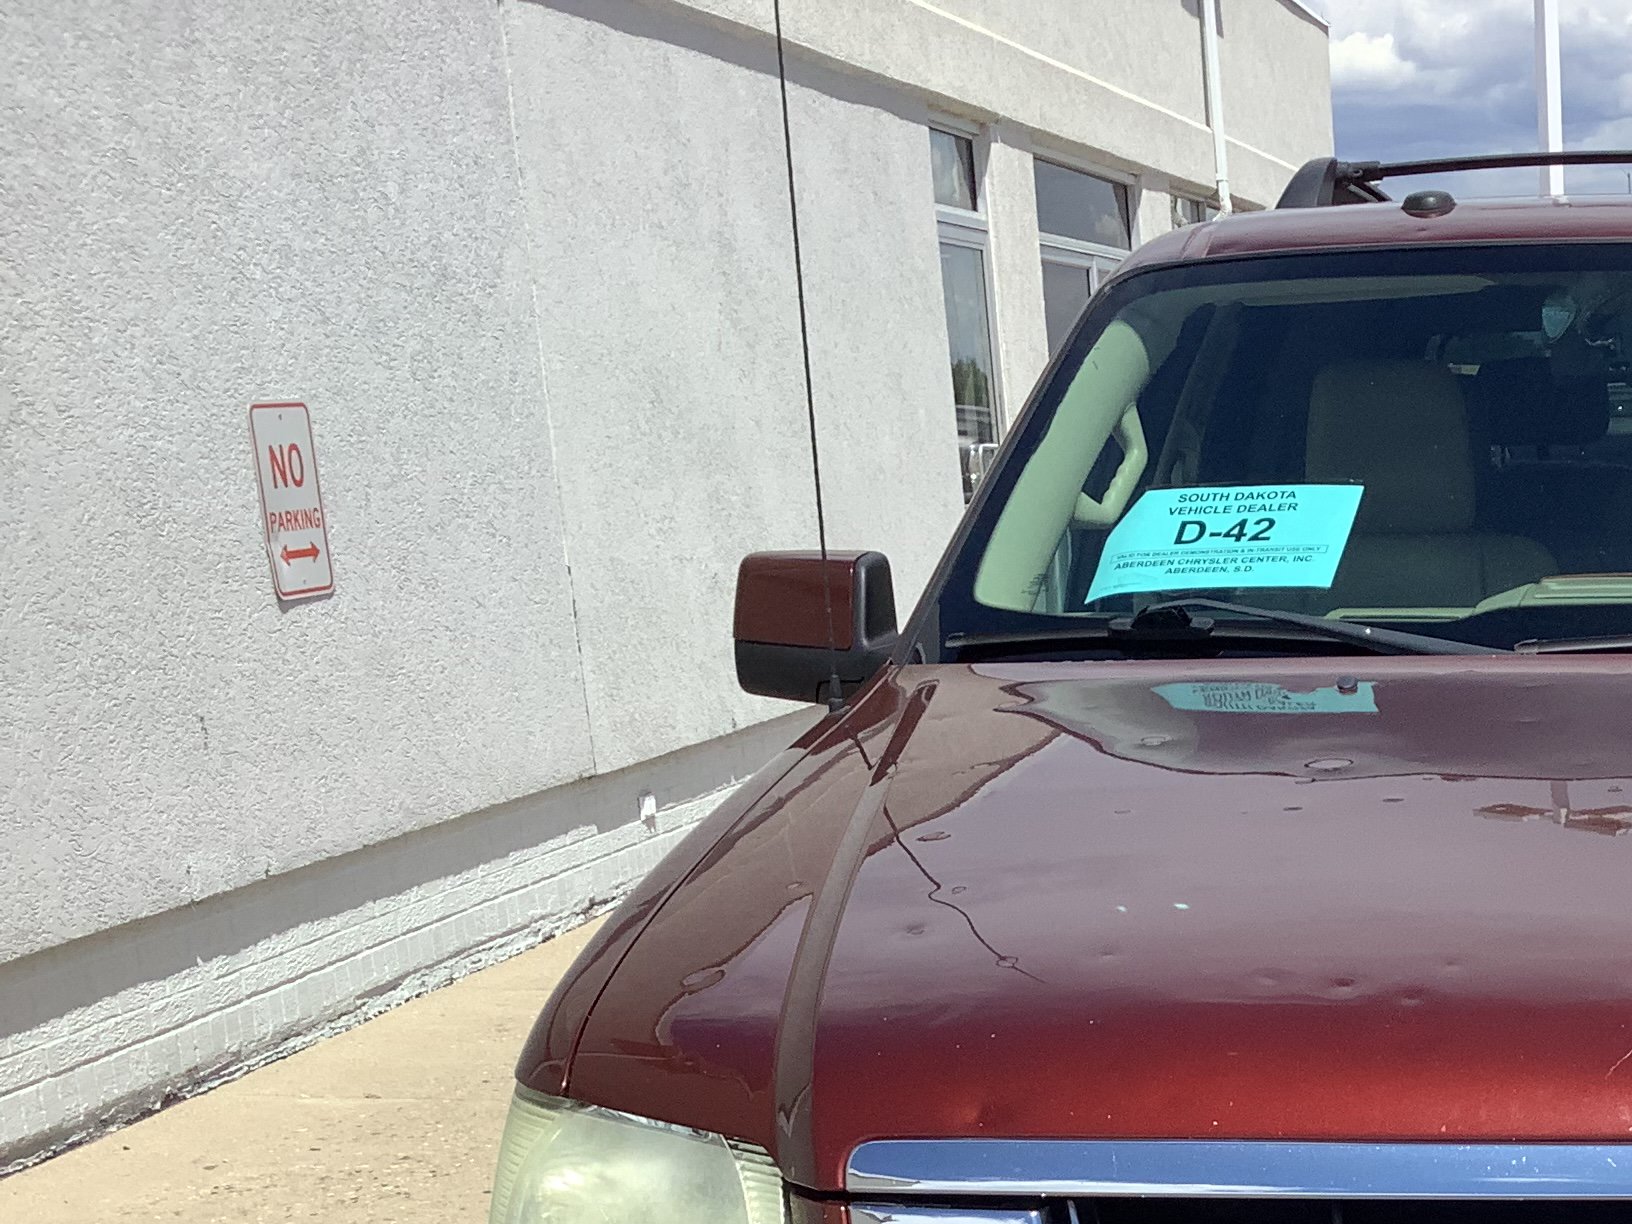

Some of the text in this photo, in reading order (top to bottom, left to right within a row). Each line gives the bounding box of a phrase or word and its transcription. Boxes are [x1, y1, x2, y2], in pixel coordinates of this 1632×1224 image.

[268, 443, 304, 489] NO
[1178, 491, 1296, 503] SOUTH DAKOTA
[1169, 503, 1298, 515] VEHICLE DEALER
[269, 508, 321, 533] PARKING
[1173, 517, 1276, 545] D-42
[1113, 560, 1175, 571] ABERDEEN
[1177, 557, 1238, 566] CHRYSLER
[1241, 555, 1289, 564] CENTER,
[1164, 566, 1230, 575] ABERDEEN,
